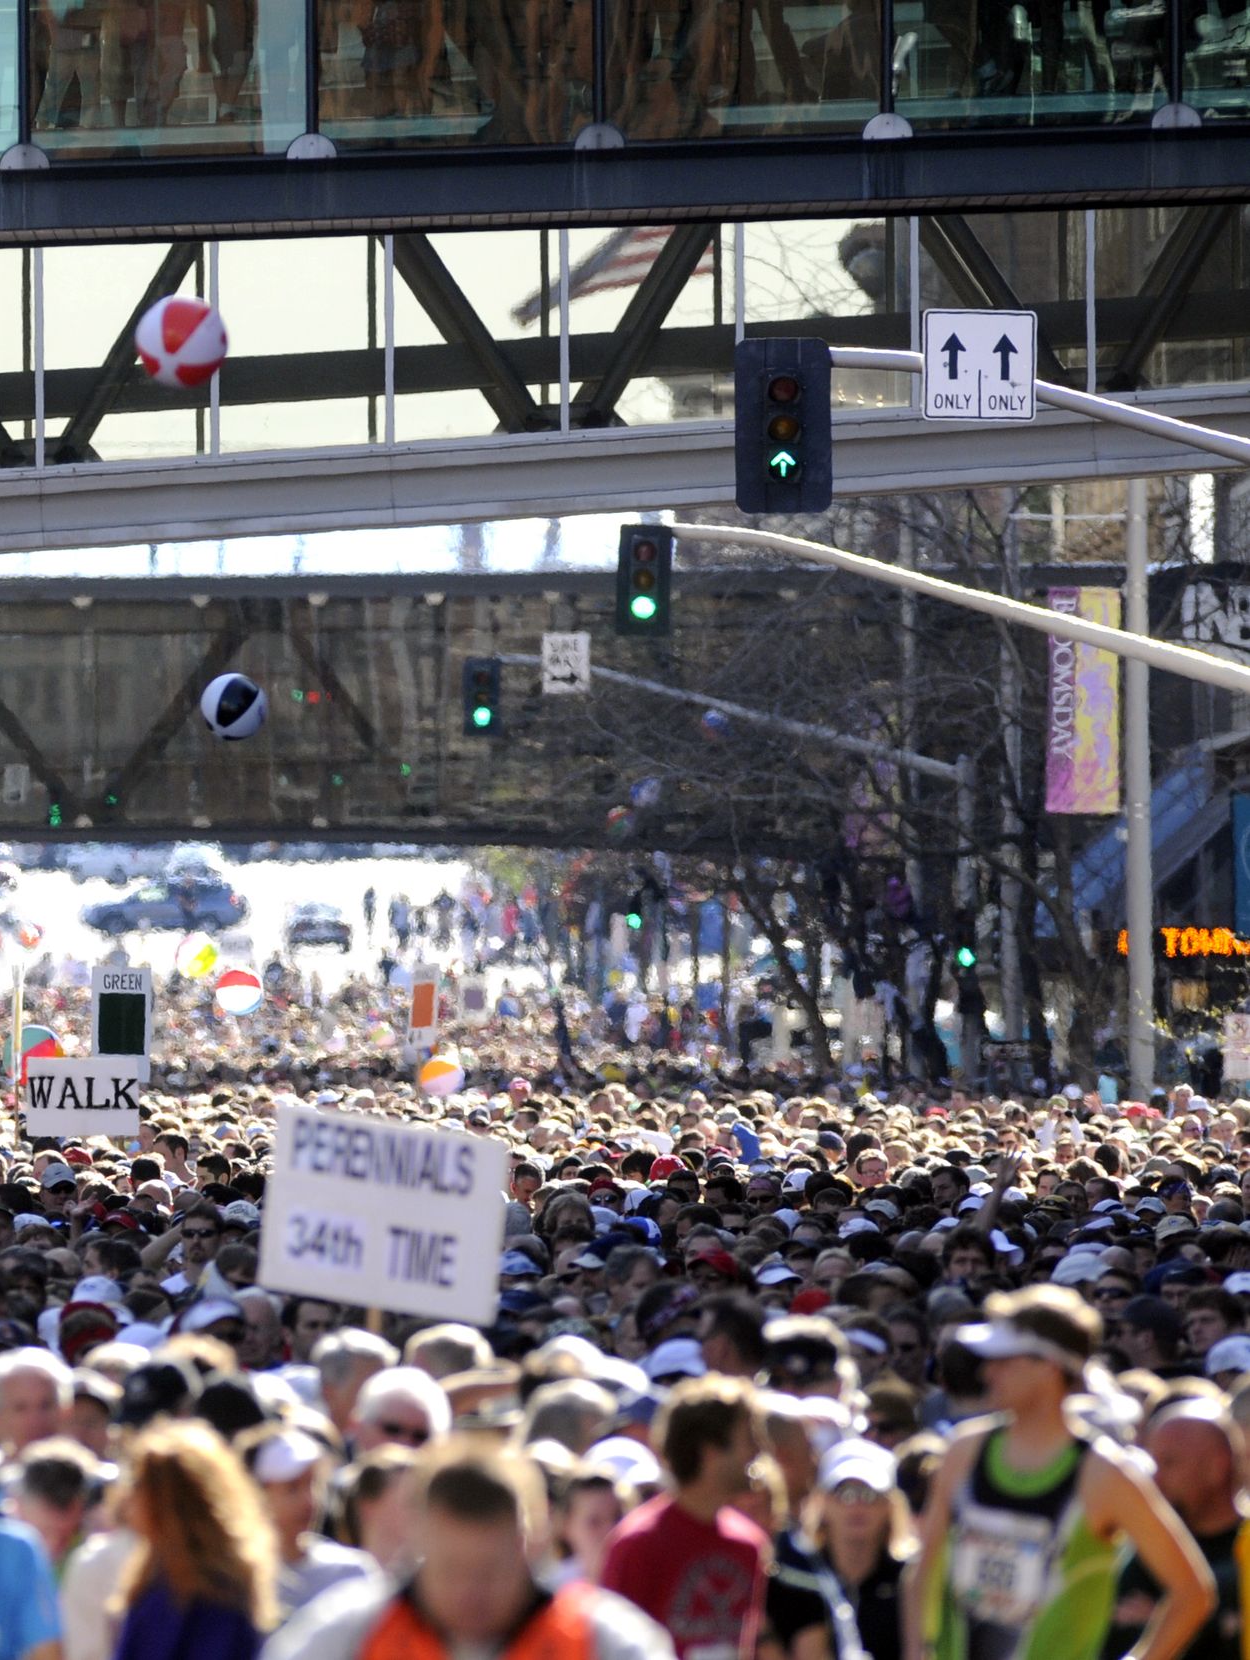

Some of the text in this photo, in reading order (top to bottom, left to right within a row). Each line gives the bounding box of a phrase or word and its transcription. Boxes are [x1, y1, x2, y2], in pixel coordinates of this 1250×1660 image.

[934, 393, 971, 410] ONLY
[988, 394, 1026, 411] ONLY
[1052, 598, 1077, 760] BOOMSDAY
[103, 973, 143, 990] GREEN
[28, 1075, 139, 1110] WALK
[291, 1118, 477, 1197] PERENNIALS
[286, 1214, 459, 1288] 34th TIME
